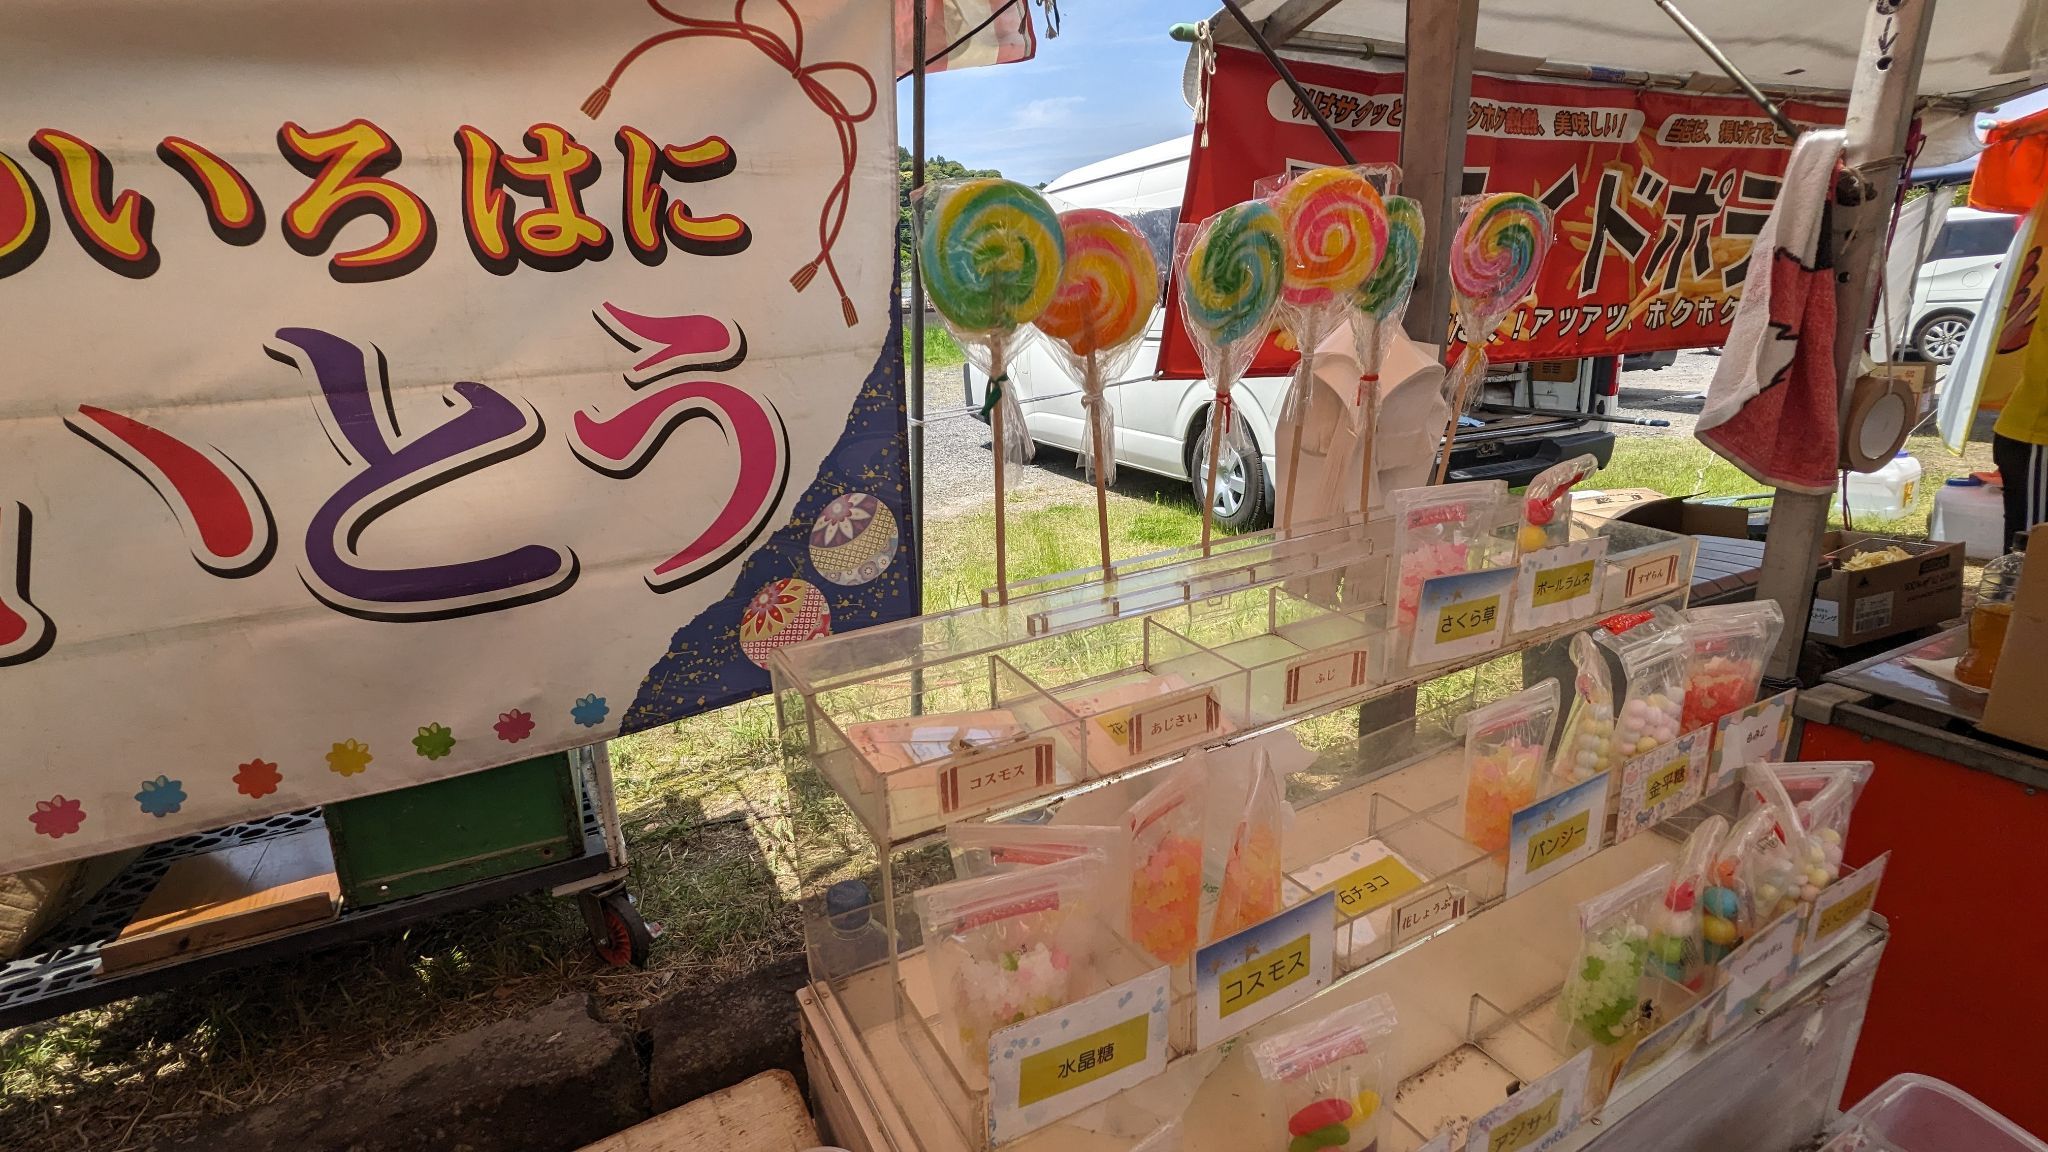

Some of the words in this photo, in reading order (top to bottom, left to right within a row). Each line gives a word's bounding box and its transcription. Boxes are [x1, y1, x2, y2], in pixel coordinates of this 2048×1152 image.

[28, 119, 752, 283] いろはに
[1441, 604, 1497, 634] さくら草
[1315, 667, 1336, 684] ふじ
[1151, 712, 1198, 736] あじさい
[970, 763, 1026, 791] コスモス
[1531, 825, 1585, 863] パンジー
[1339, 875, 1390, 905] 石チョコ
[1225, 950, 1306, 1005] コスモス
[1057, 1042, 1115, 1080] 水晶糖
[1495, 1102, 1558, 1152] アジサイ
